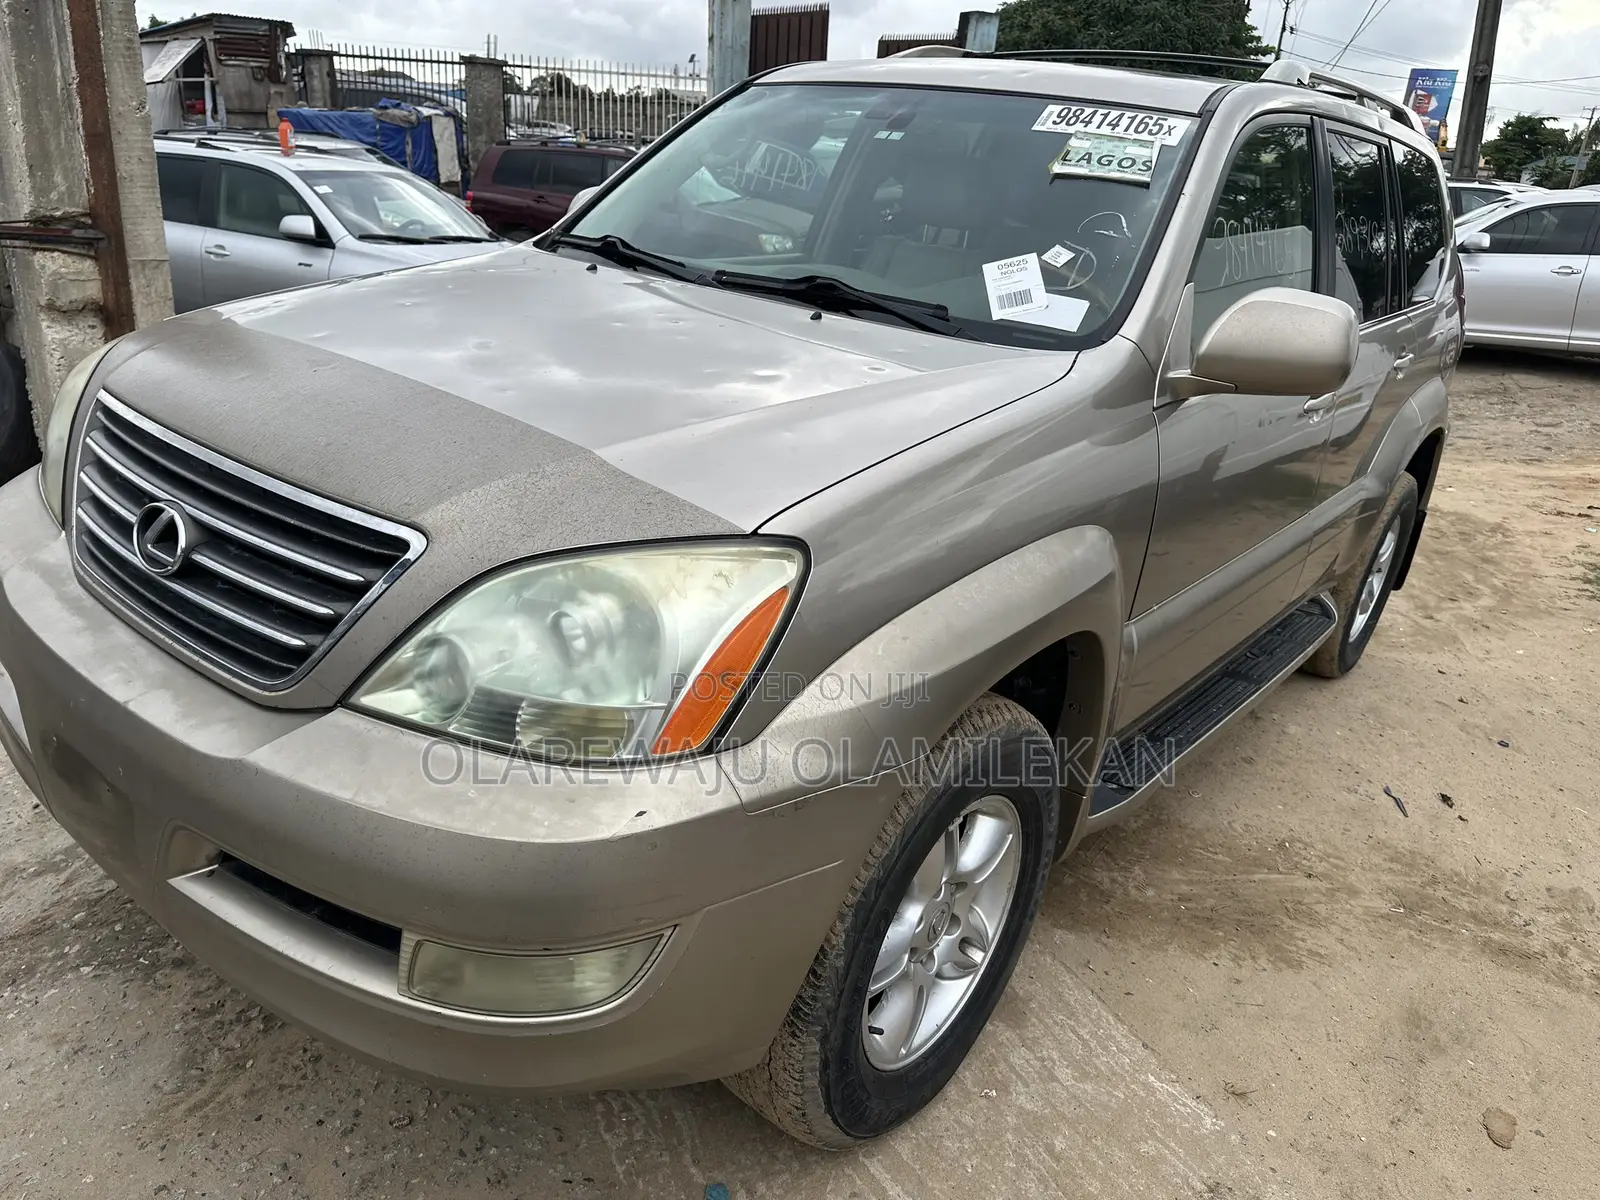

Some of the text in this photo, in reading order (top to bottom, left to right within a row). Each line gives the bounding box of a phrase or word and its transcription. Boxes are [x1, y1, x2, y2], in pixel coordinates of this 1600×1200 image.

[1061, 149, 1153, 172] LAGOS
[997, 258, 1029, 271] 05625
[1000, 266, 1028, 276] NGLOS
